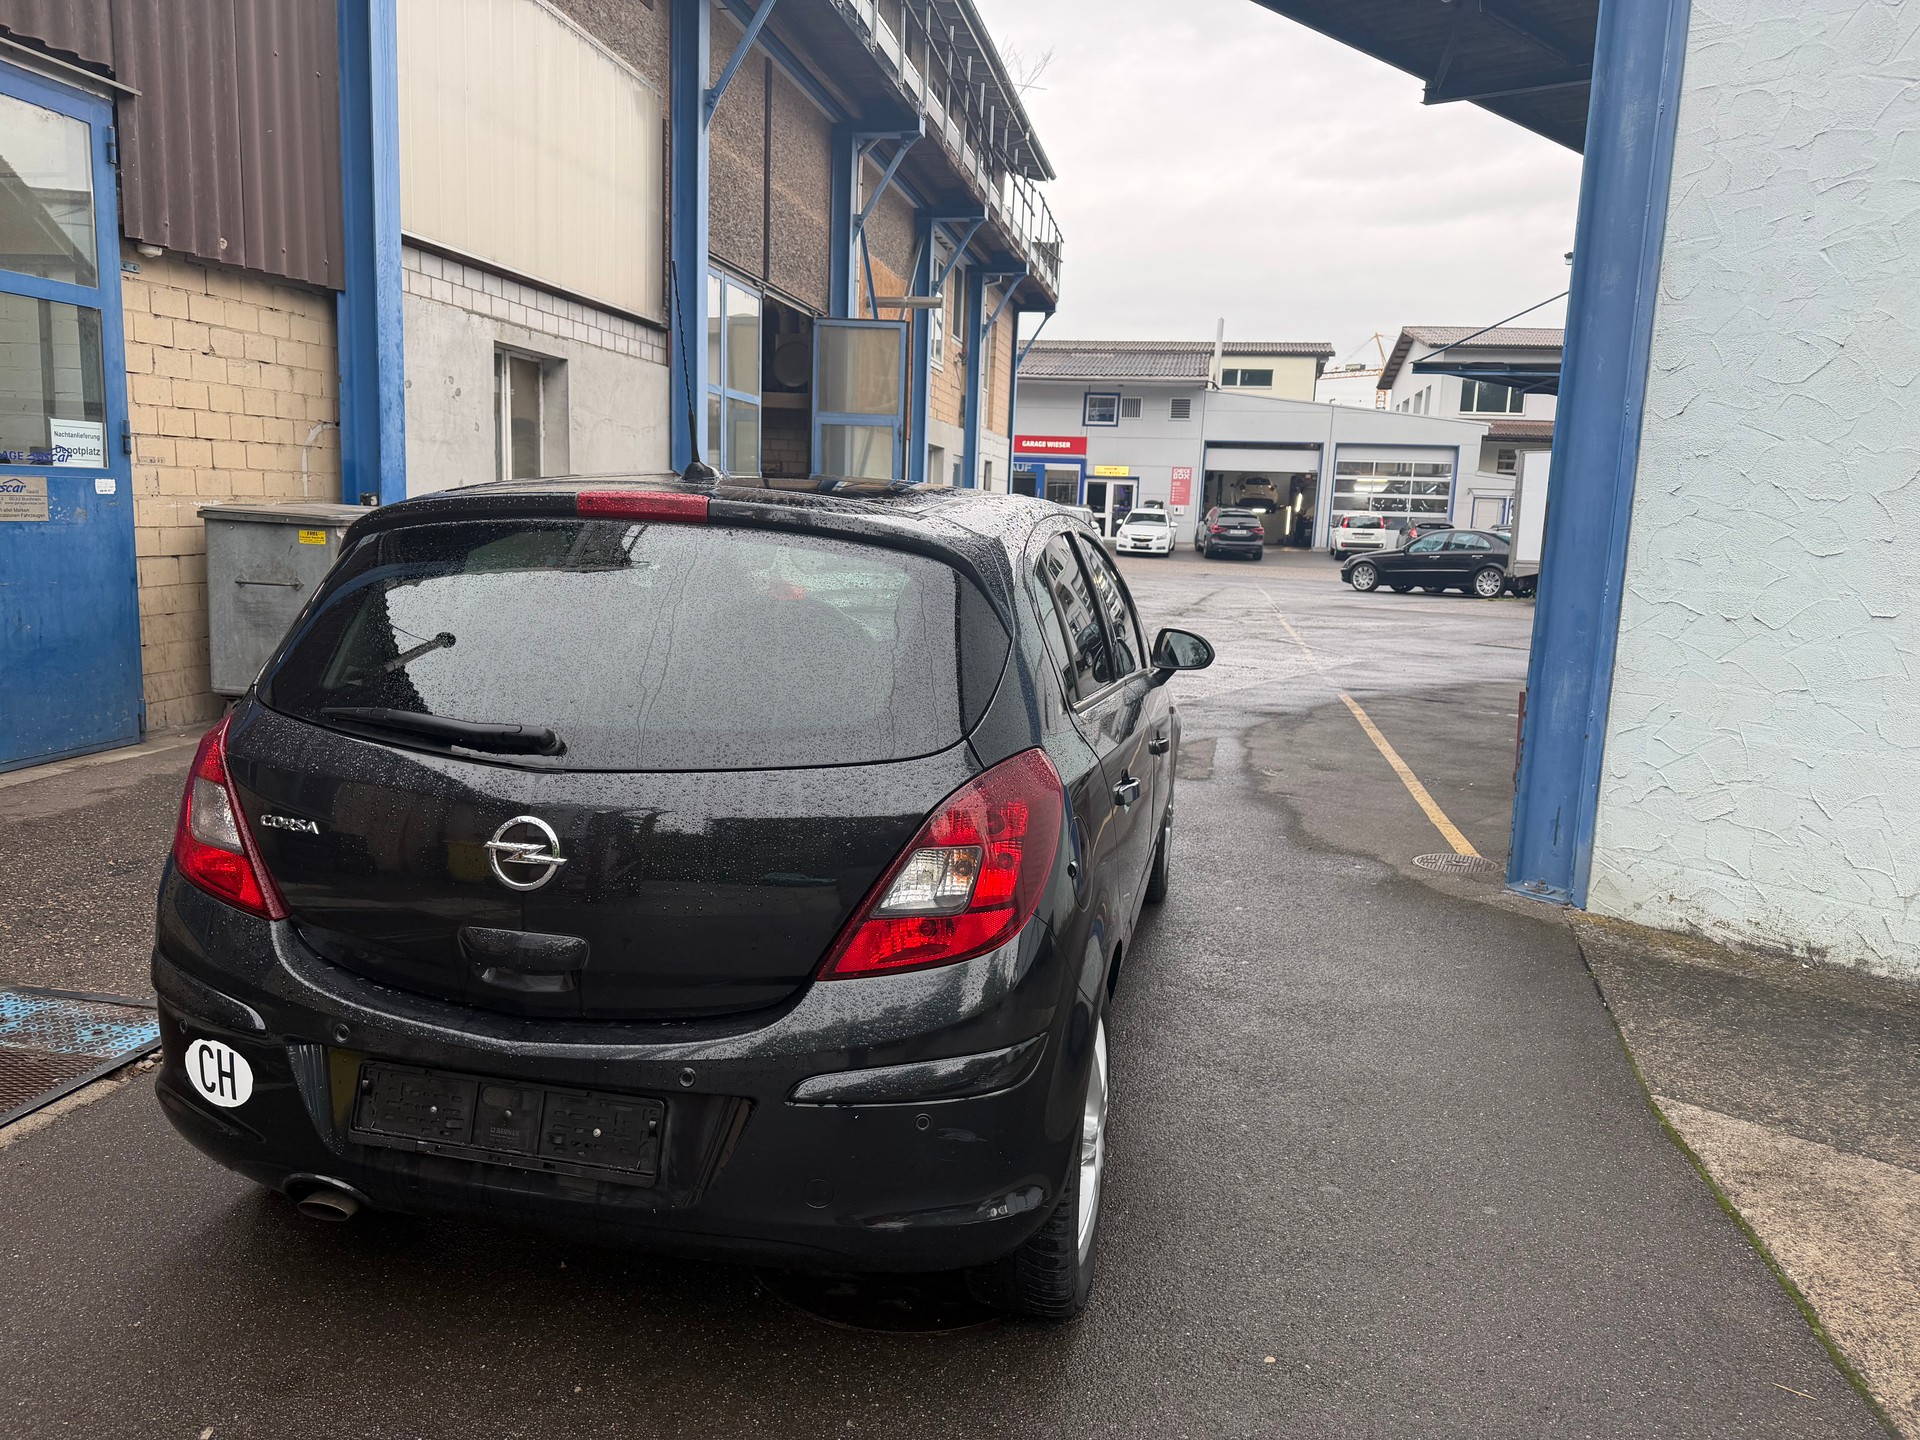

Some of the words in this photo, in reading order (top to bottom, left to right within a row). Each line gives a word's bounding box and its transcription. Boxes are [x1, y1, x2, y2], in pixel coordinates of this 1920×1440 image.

[53, 430, 101, 441] Nachtanlieferung
[55, 444, 101, 457] Depotplatz
[1022, 440, 1046, 448] GARAGE
[1047, 441, 1071, 449] WIESER
[260, 814, 319, 835] CORSA
[199, 1044, 237, 1101] CH
